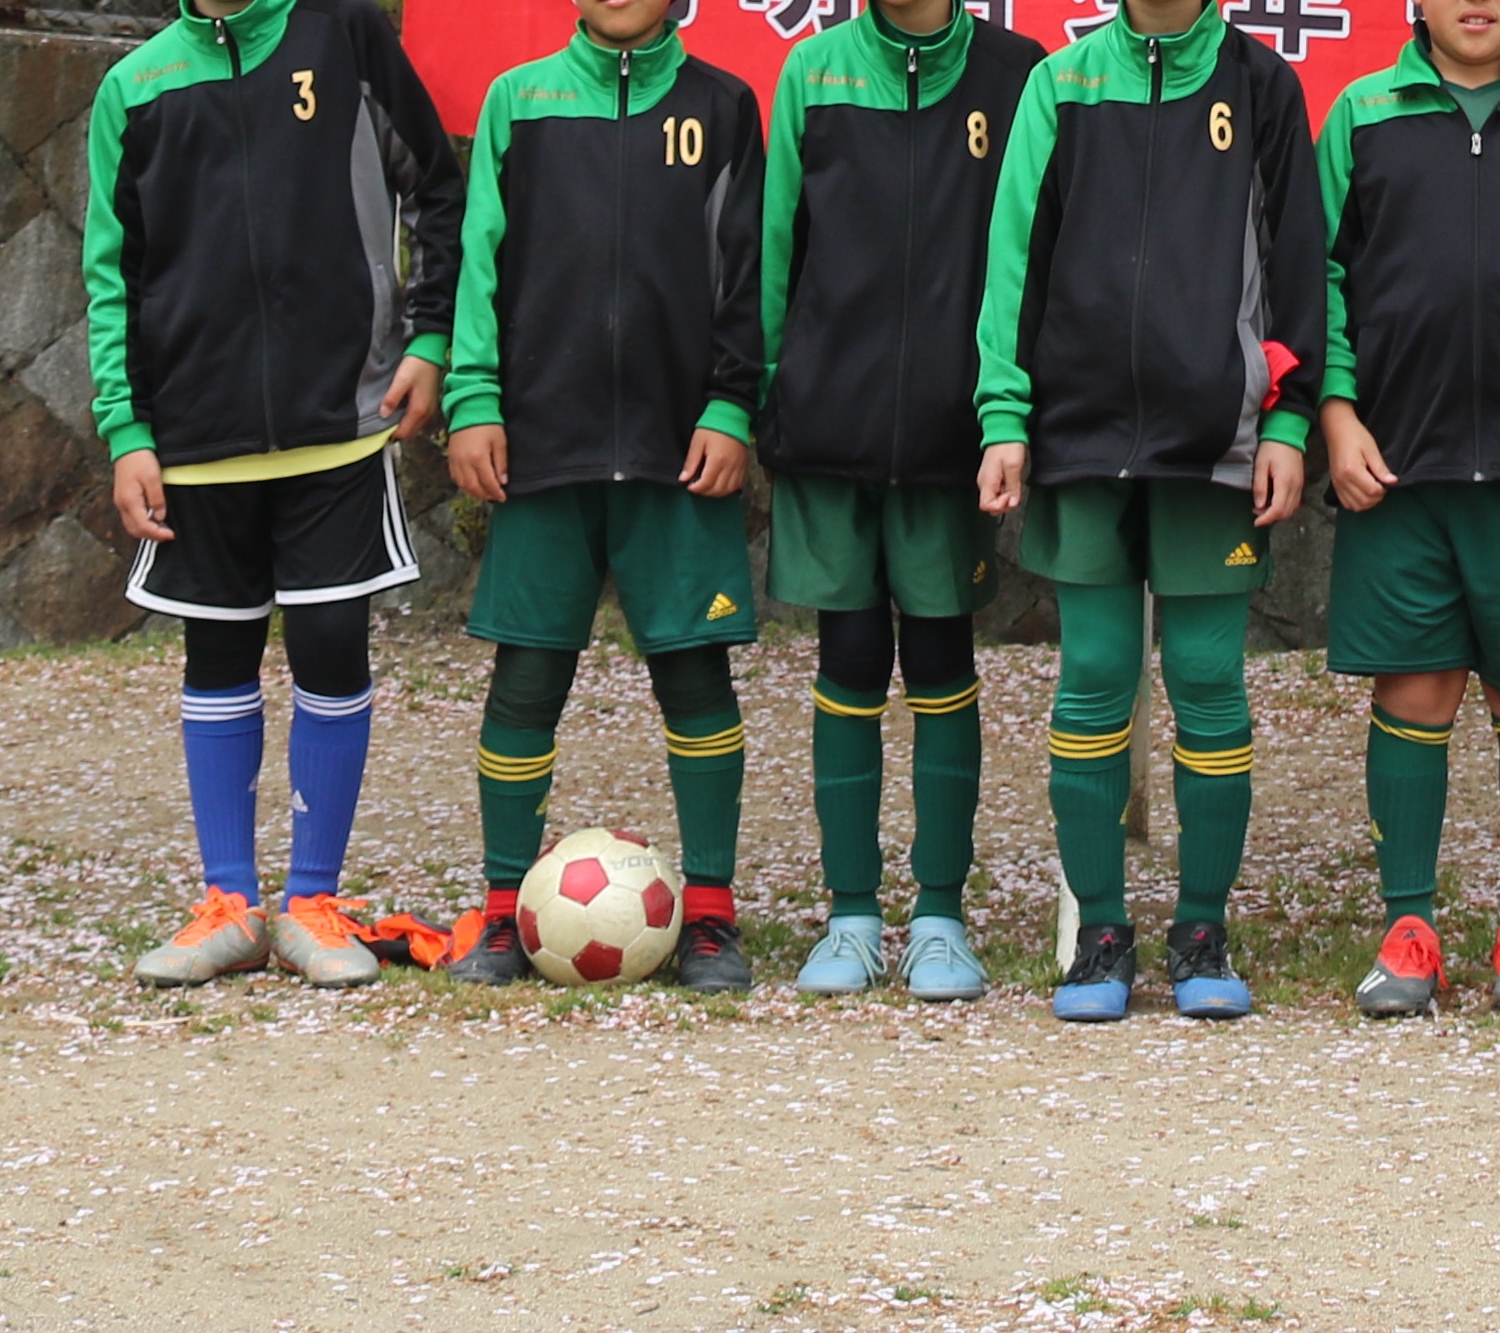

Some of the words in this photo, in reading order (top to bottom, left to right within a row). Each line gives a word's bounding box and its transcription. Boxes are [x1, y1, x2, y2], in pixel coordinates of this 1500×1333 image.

[291, 69, 317, 122] 3
[662, 115, 704, 167] 10
[966, 110, 990, 160] 8
[1208, 101, 1234, 152] 6
